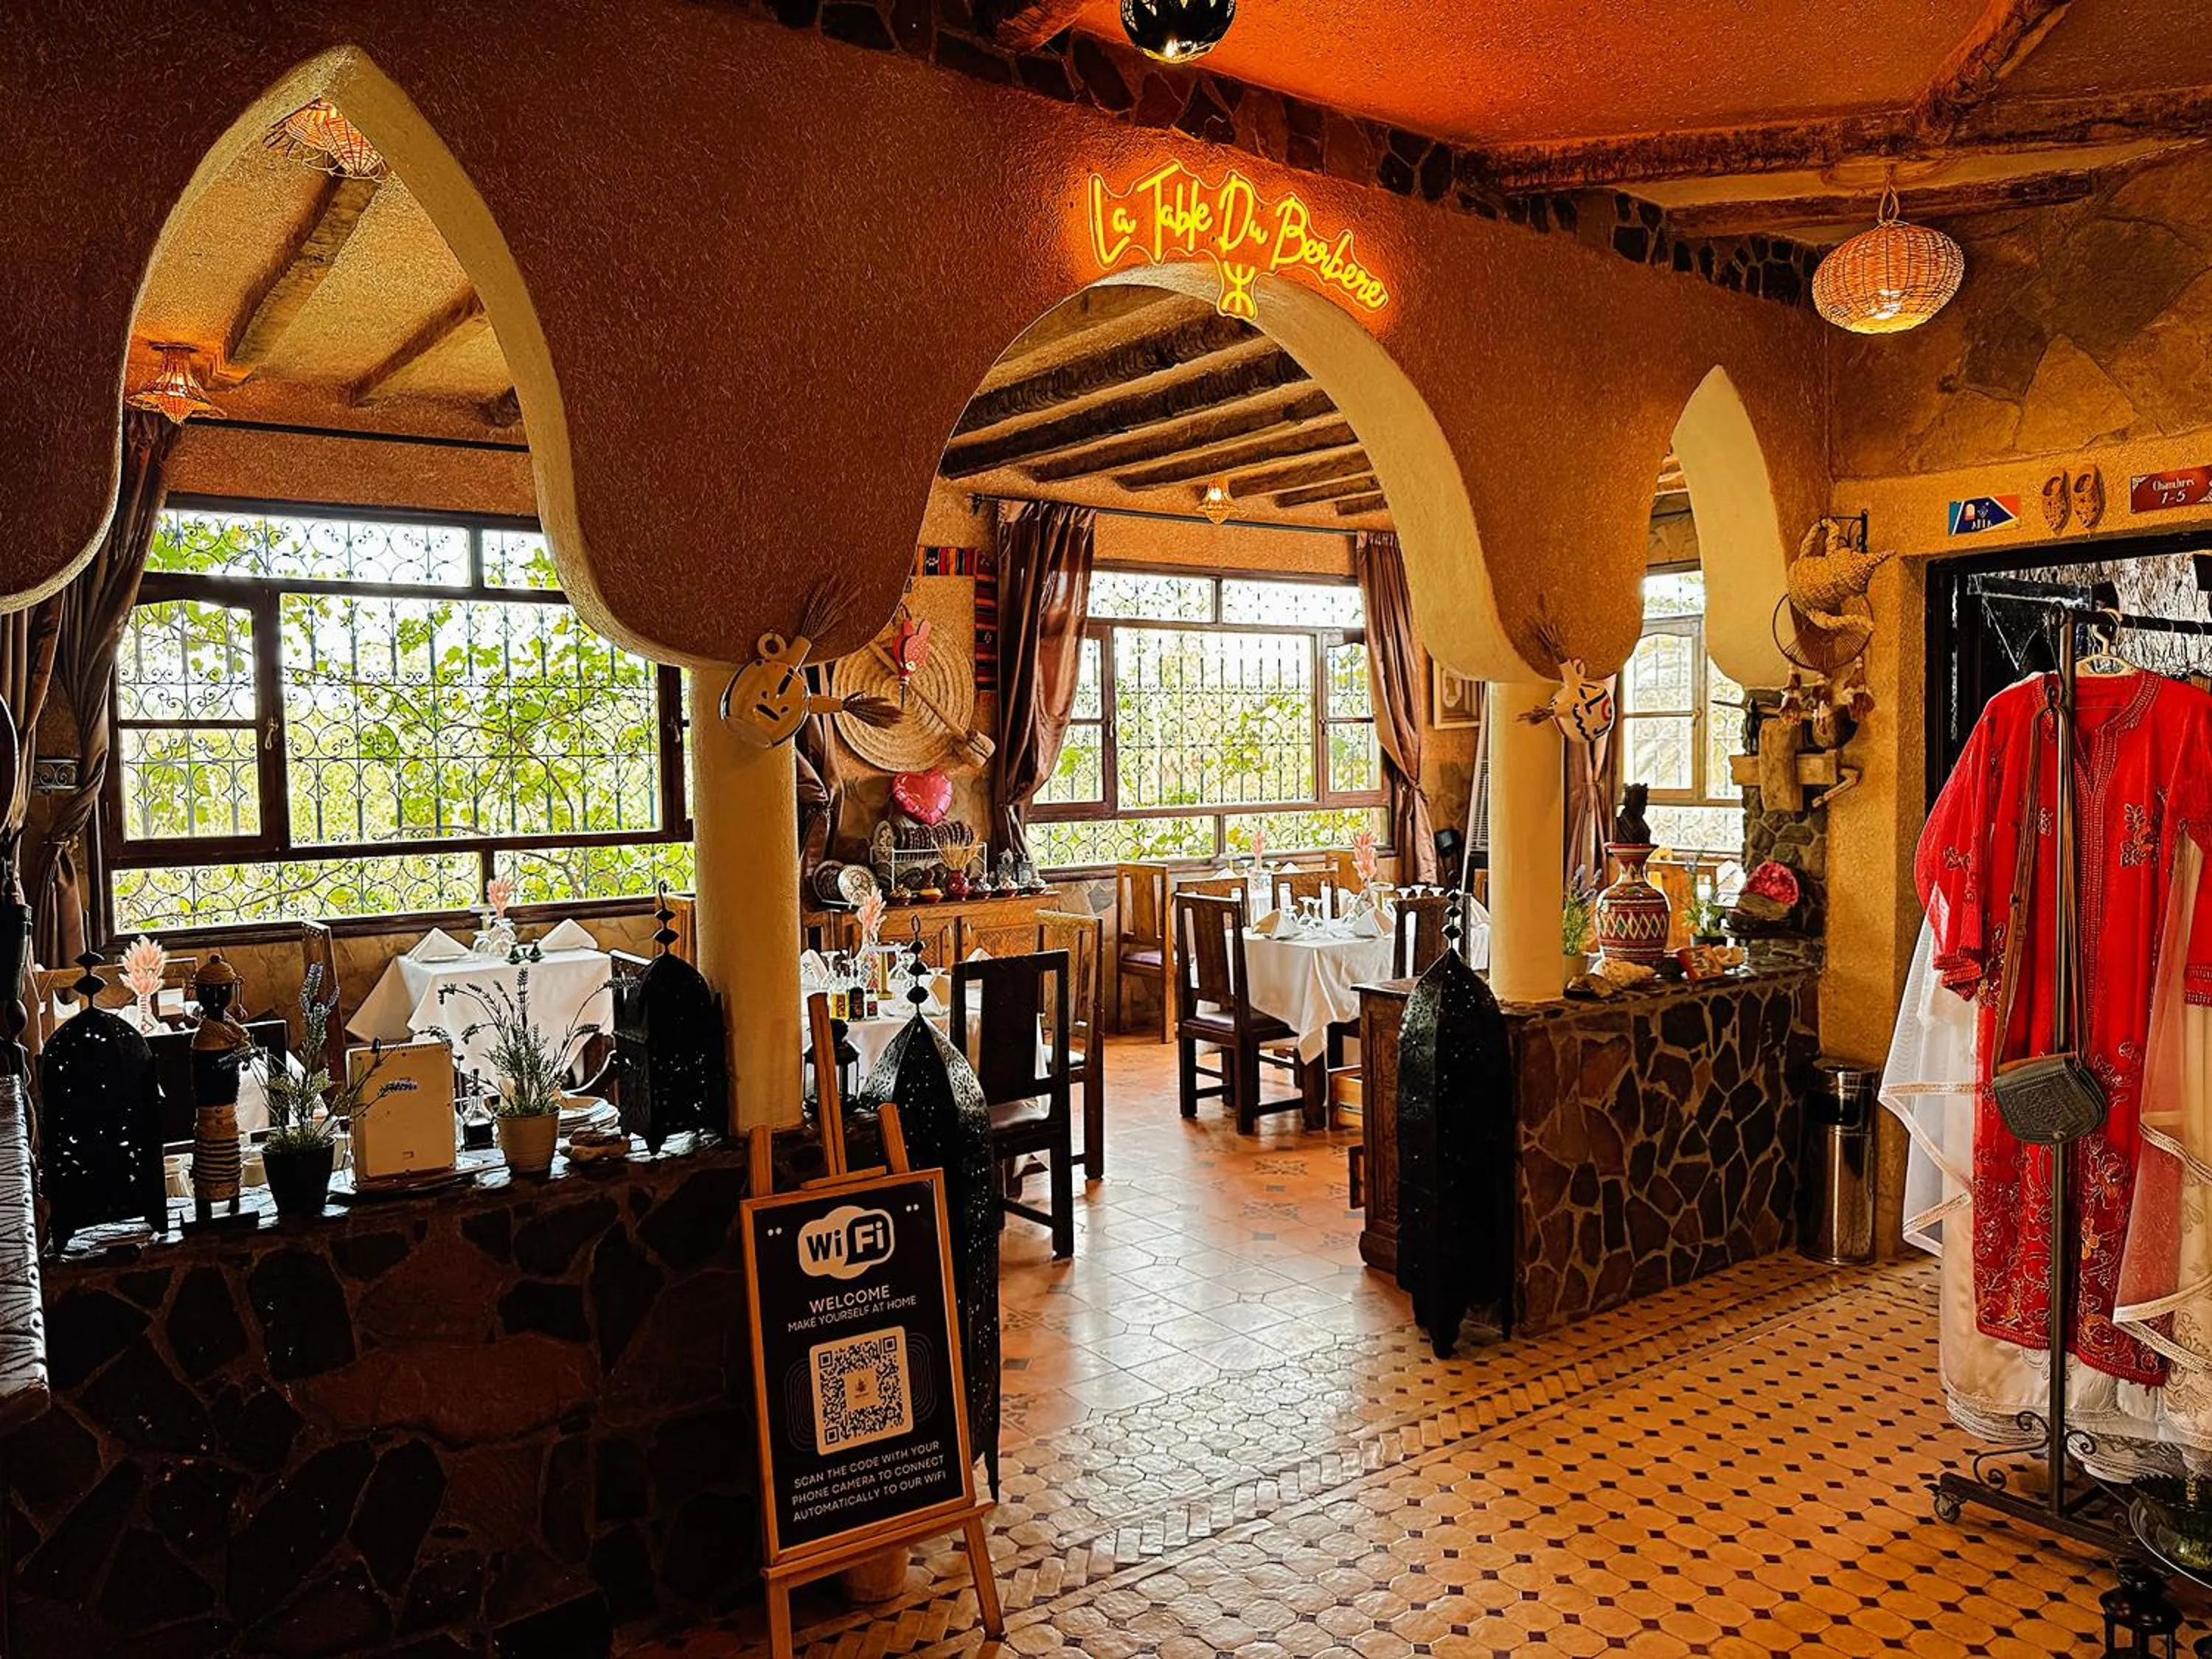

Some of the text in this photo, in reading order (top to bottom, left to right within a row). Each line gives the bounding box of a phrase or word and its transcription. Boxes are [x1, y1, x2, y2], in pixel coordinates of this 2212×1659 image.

[1094, 163, 1386, 308] La Table Du Berbere
[787, 1295, 917, 1332] MAKE YOURSELF AT HOME
[809, 1284, 890, 1314] WELCOME
[791, 1454, 944, 1506] PHONE CAMERA TO CONNECT
[794, 1440, 939, 1489] SCAN THE CODE WITH YOUR
[793, 1470, 946, 1523] AUTOMATICALLY TO OUR WIFI
